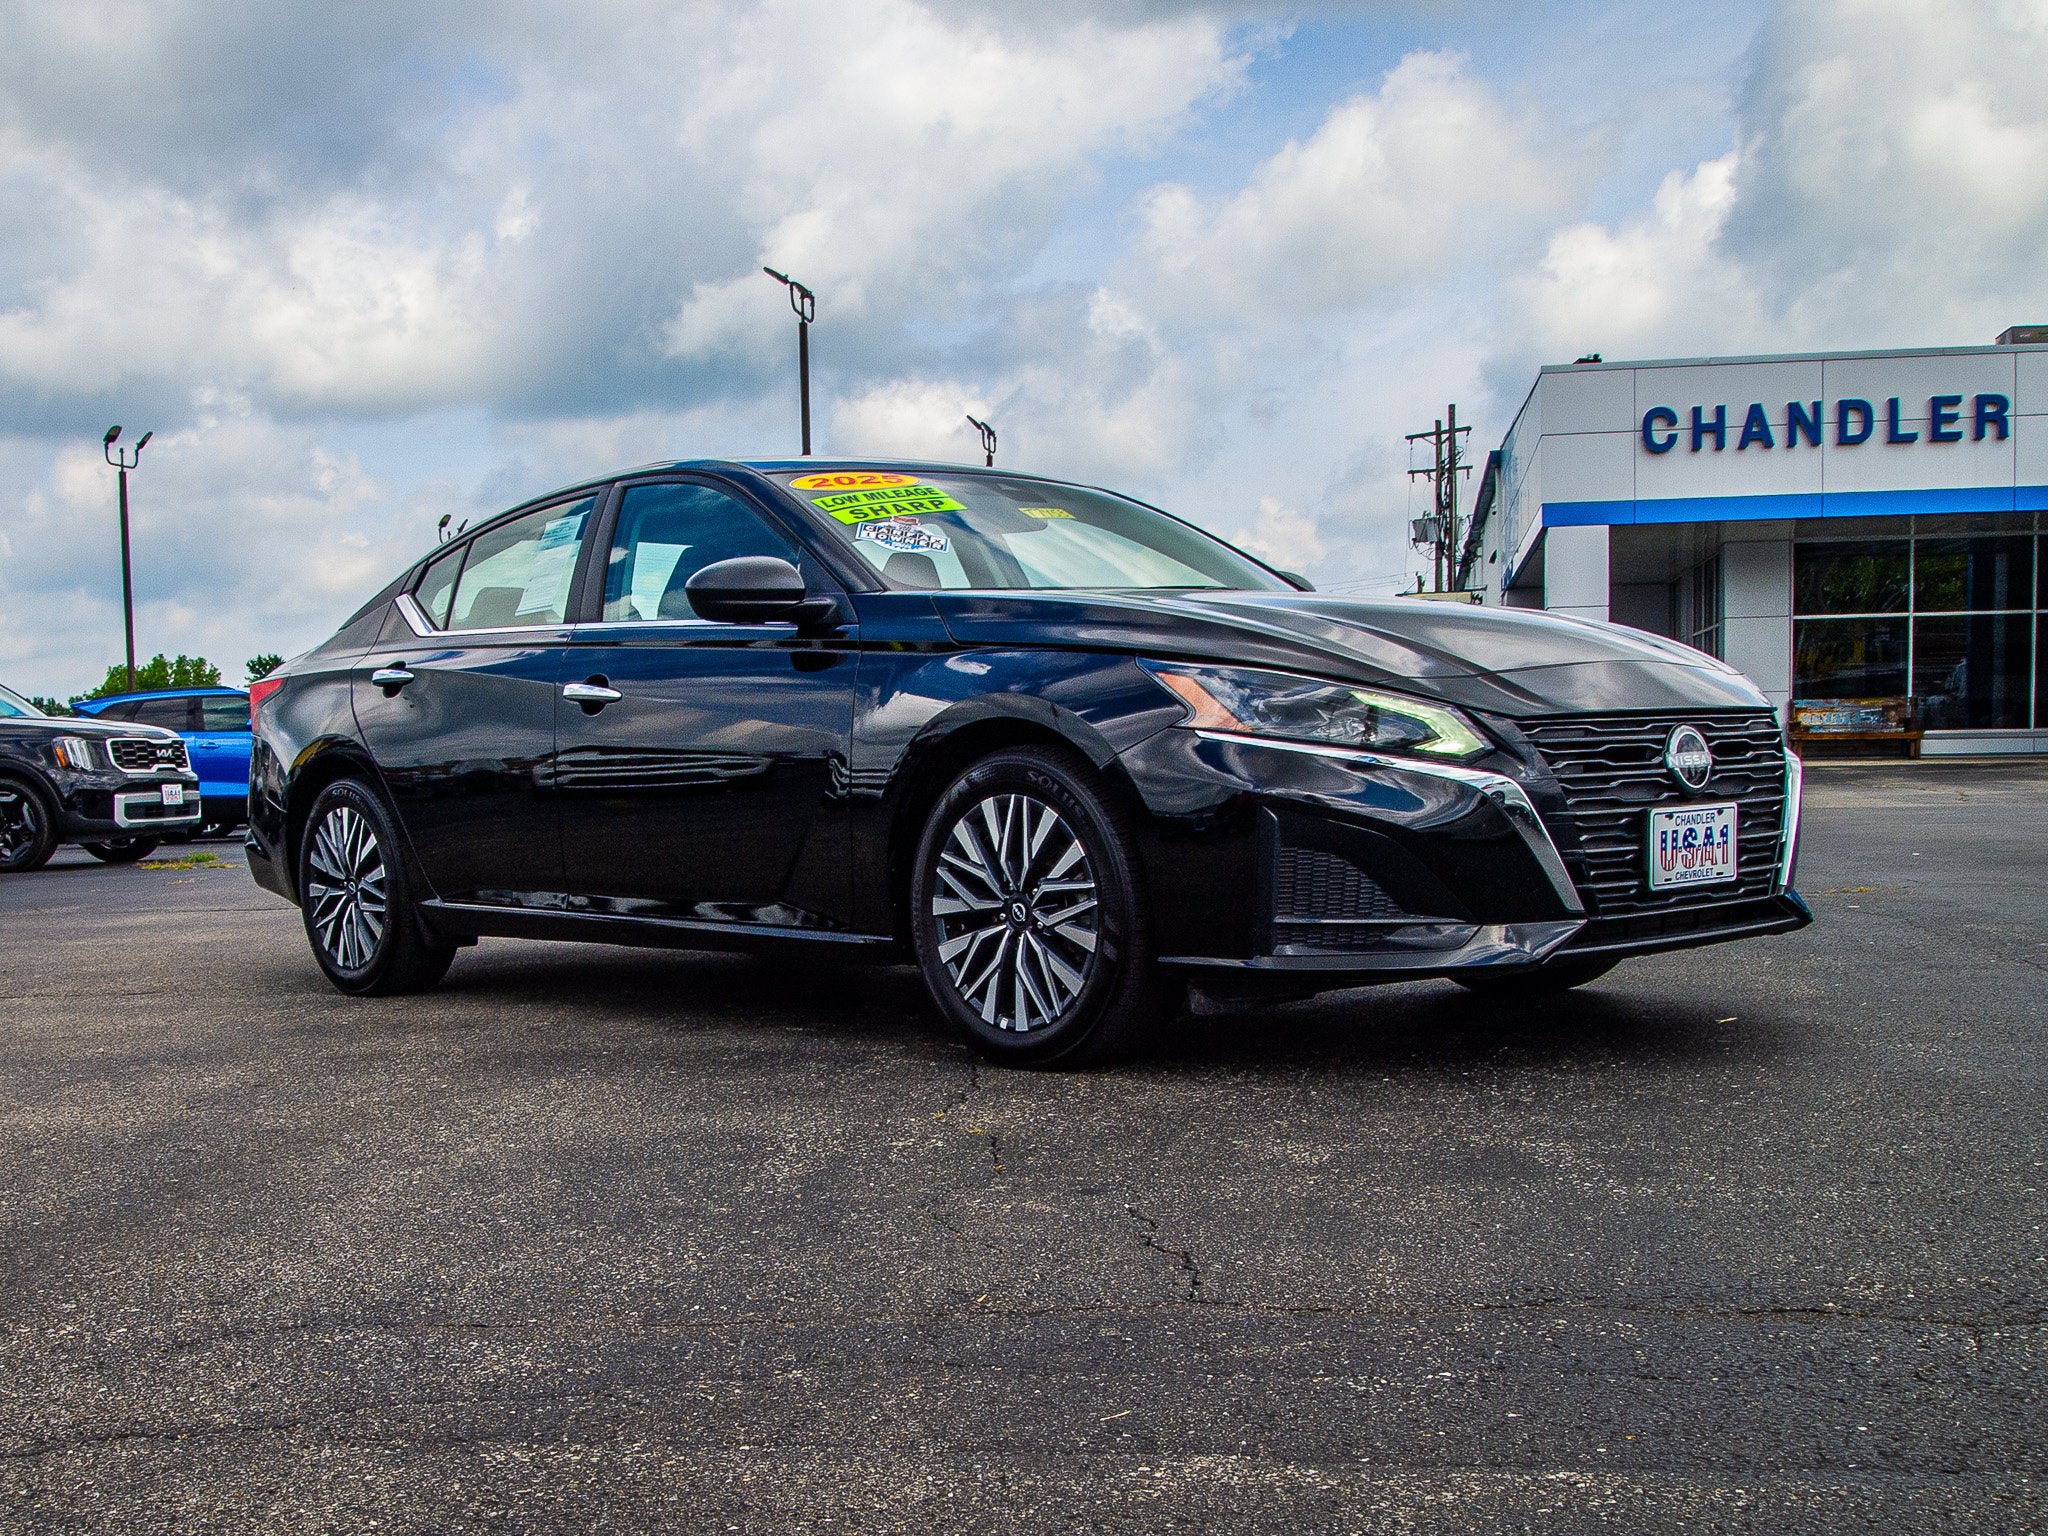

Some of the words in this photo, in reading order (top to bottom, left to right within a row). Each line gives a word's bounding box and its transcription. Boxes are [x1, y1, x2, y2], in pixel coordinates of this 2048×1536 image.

[1641, 393, 2011, 453] CHANDLER
[809, 474, 904, 489] 2025
[820, 496, 862, 508] LOW
[866, 486, 938, 502] MILEAGE
[849, 500, 946, 520] SHARP
[1675, 813, 1716, 827] CHANDLER
[1675, 868, 1714, 881] CHEVROLET
